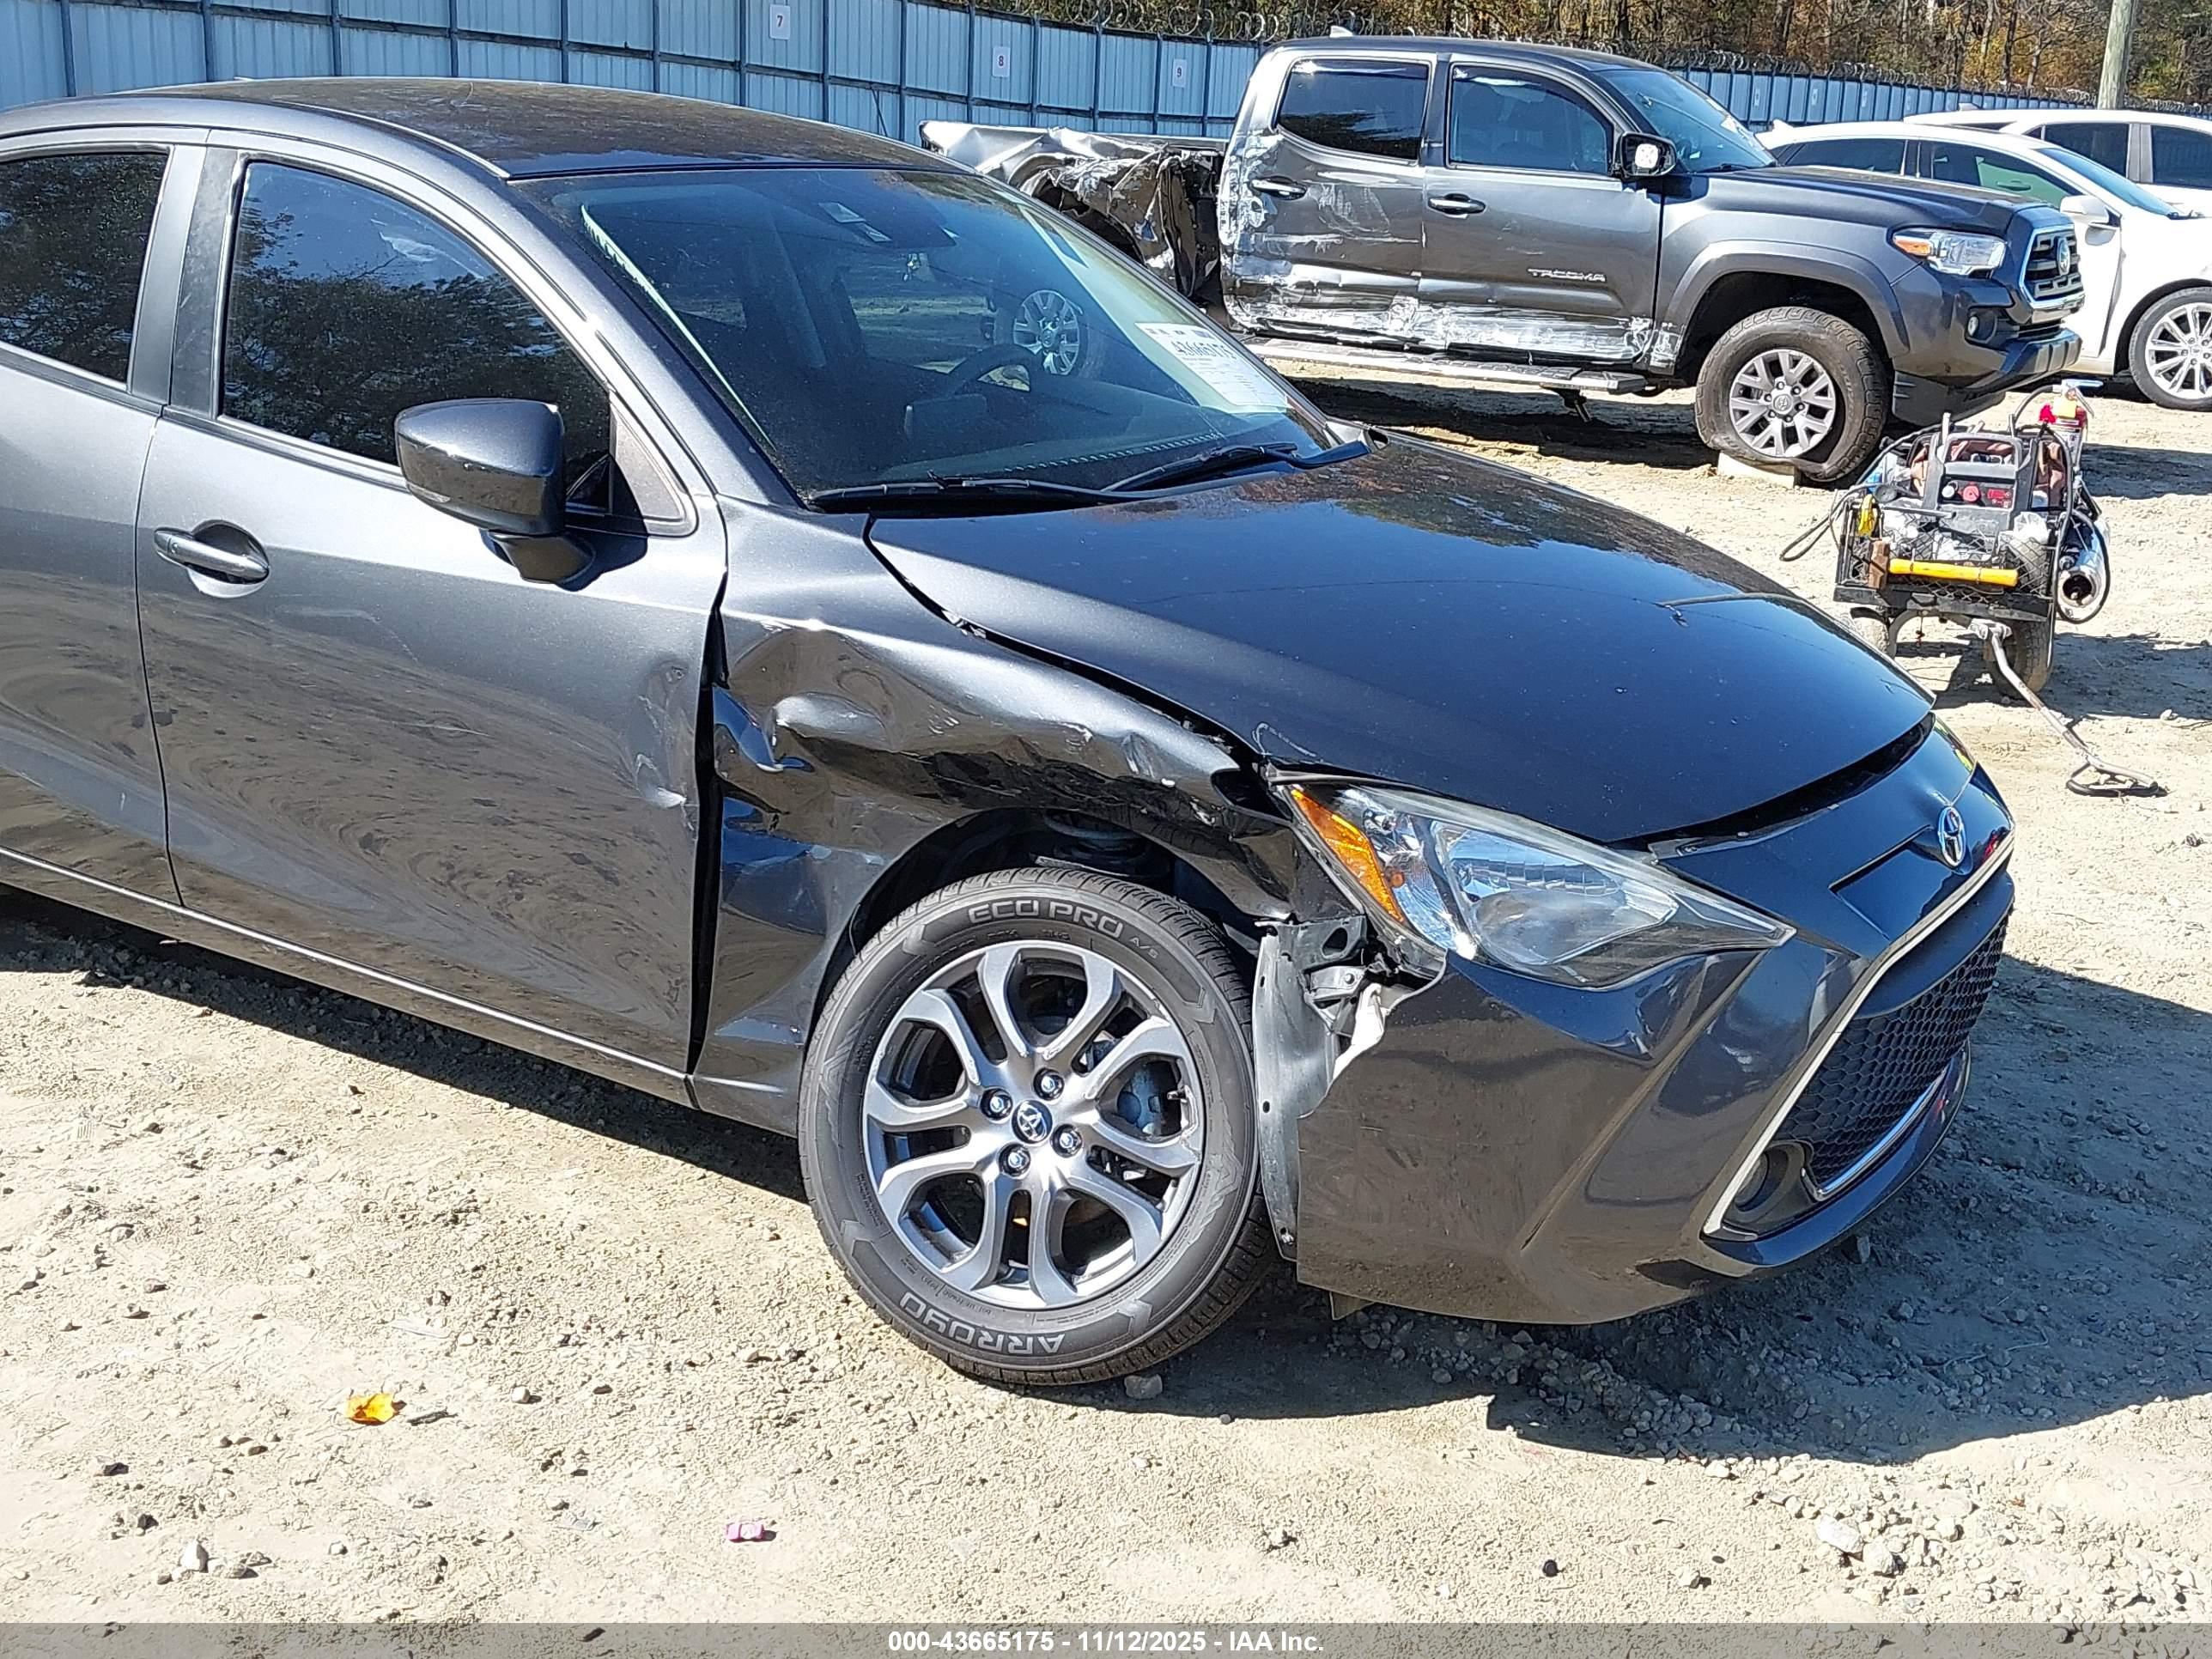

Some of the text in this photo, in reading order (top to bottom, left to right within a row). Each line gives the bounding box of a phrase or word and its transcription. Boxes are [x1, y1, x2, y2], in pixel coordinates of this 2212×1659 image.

[777, 15, 783, 27] 7
[998, 55, 1004, 66] 8
[1176, 67, 1182, 77] 9
[1528, 268, 1606, 283] TACOMA
[969, 900, 1039, 923] ECO
[1048, 902, 1123, 939] PRO
[1129, 937, 1158, 959] A/S
[900, 1291, 1065, 1354] ARROYO
